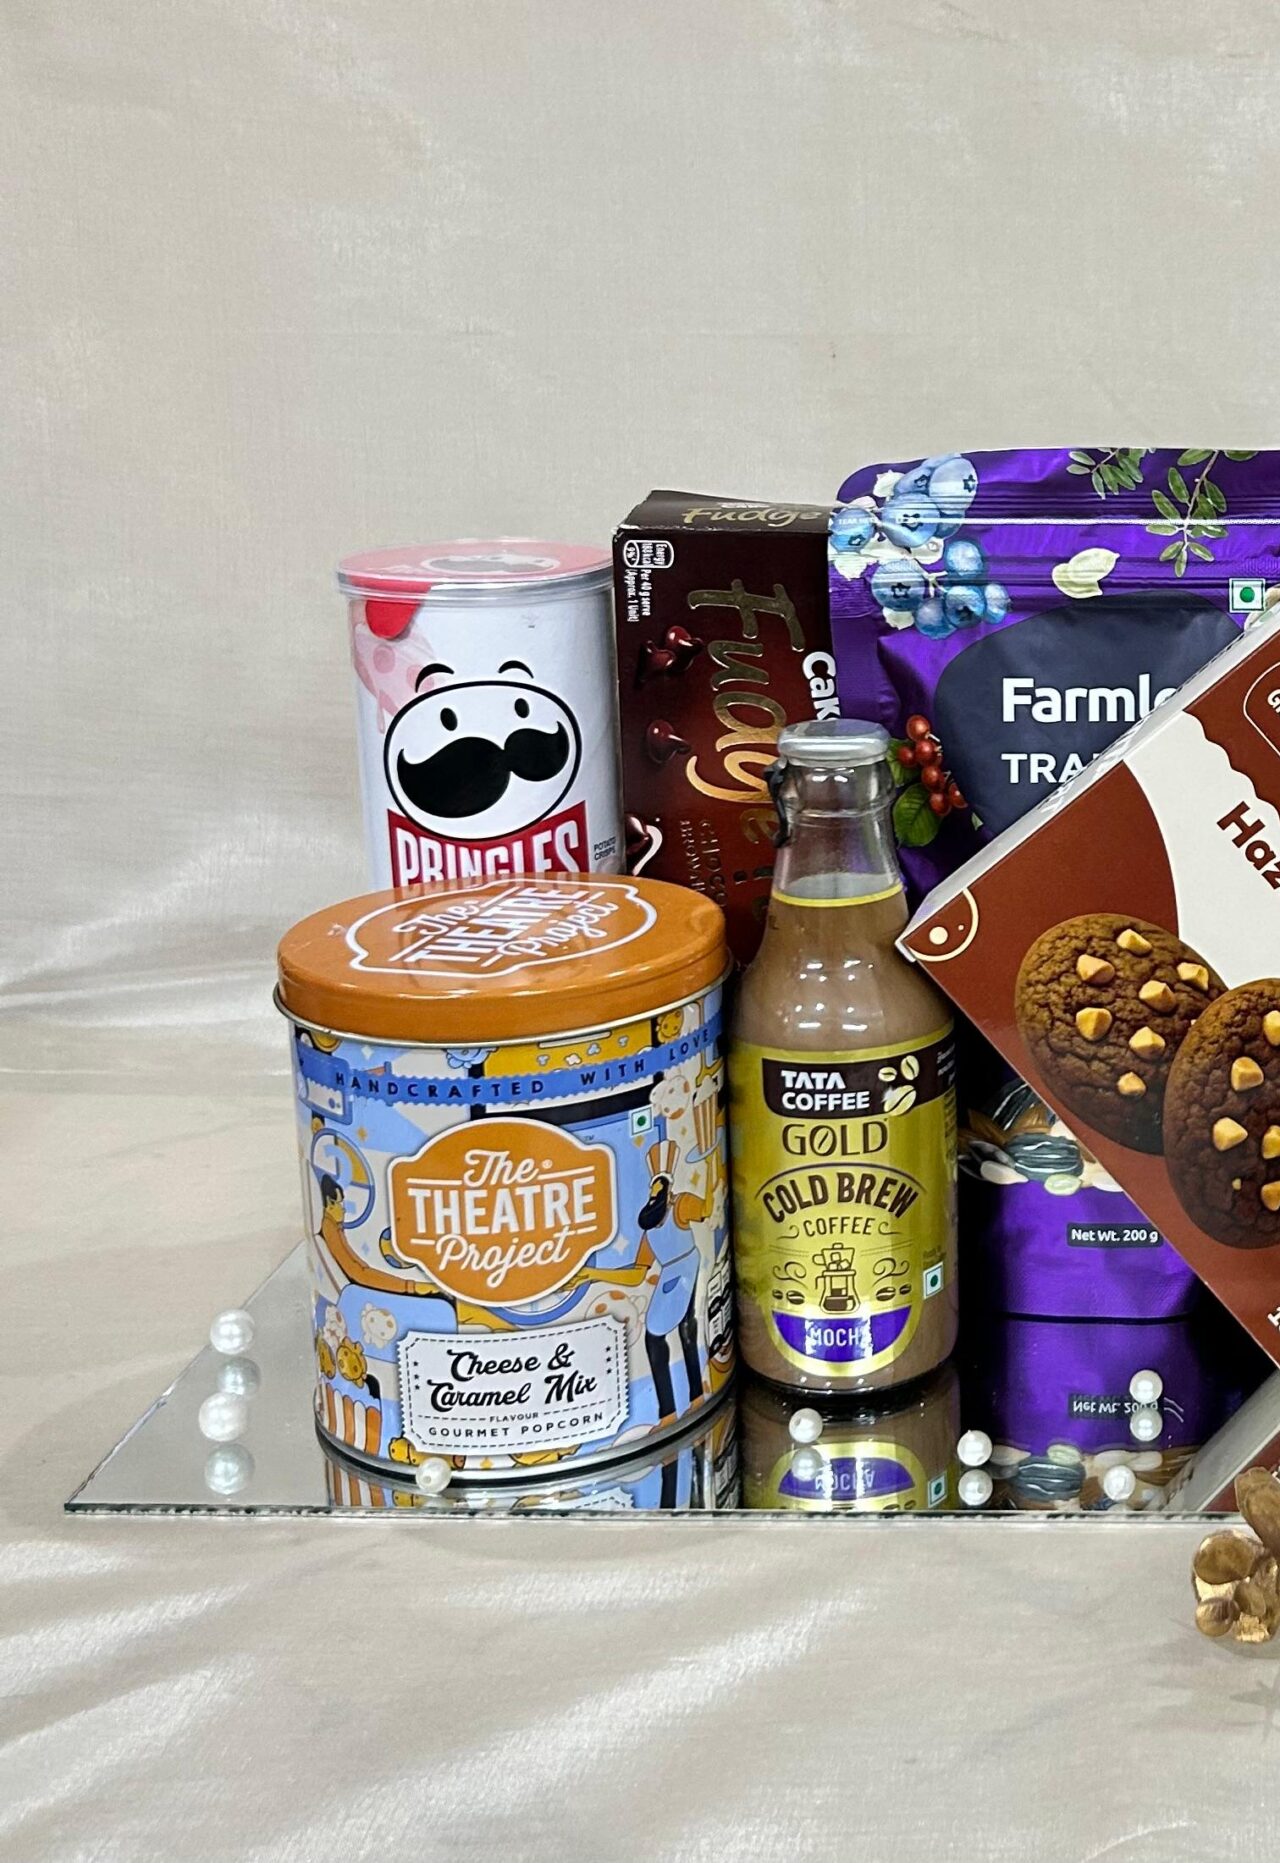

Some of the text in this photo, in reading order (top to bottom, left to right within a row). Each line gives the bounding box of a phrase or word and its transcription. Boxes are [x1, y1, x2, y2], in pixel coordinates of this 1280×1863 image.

[681, 506, 822, 527] Fudge
[653, 543, 668, 565] Energy
[640, 569, 652, 580] Per
[641, 597, 651, 616] serve
[801, 651, 841, 721] Cak
[1001, 753, 1101, 784] TRA
[594, 836, 617, 852] POTATO
[392, 899, 481, 936] The
[403, 886, 590, 963] THEATRE
[497, 895, 620, 957] Project
[335, 1028, 711, 1099] HANDCRAFTED WITH LOVE
[781, 1069, 846, 1091] TATA
[781, 1090, 870, 1112] COFFEE
[782, 1120, 889, 1158] GOLD
[463, 1149, 540, 1188] The
[407, 1174, 597, 1236] THEATRE
[762, 1171, 919, 1224] COLD BREW
[803, 1216, 876, 1237] COFFEE
[1071, 1228, 1159, 1244] Net Wt. 200 g
[434, 1226, 573, 1288] Project
[446, 1341, 575, 1382] Cheese &
[427, 1369, 598, 1413] Caramel Mix
[428, 1410, 605, 1438] GOURMET POPCORN
[489, 1411, 540, 1423] FLAVOUR
